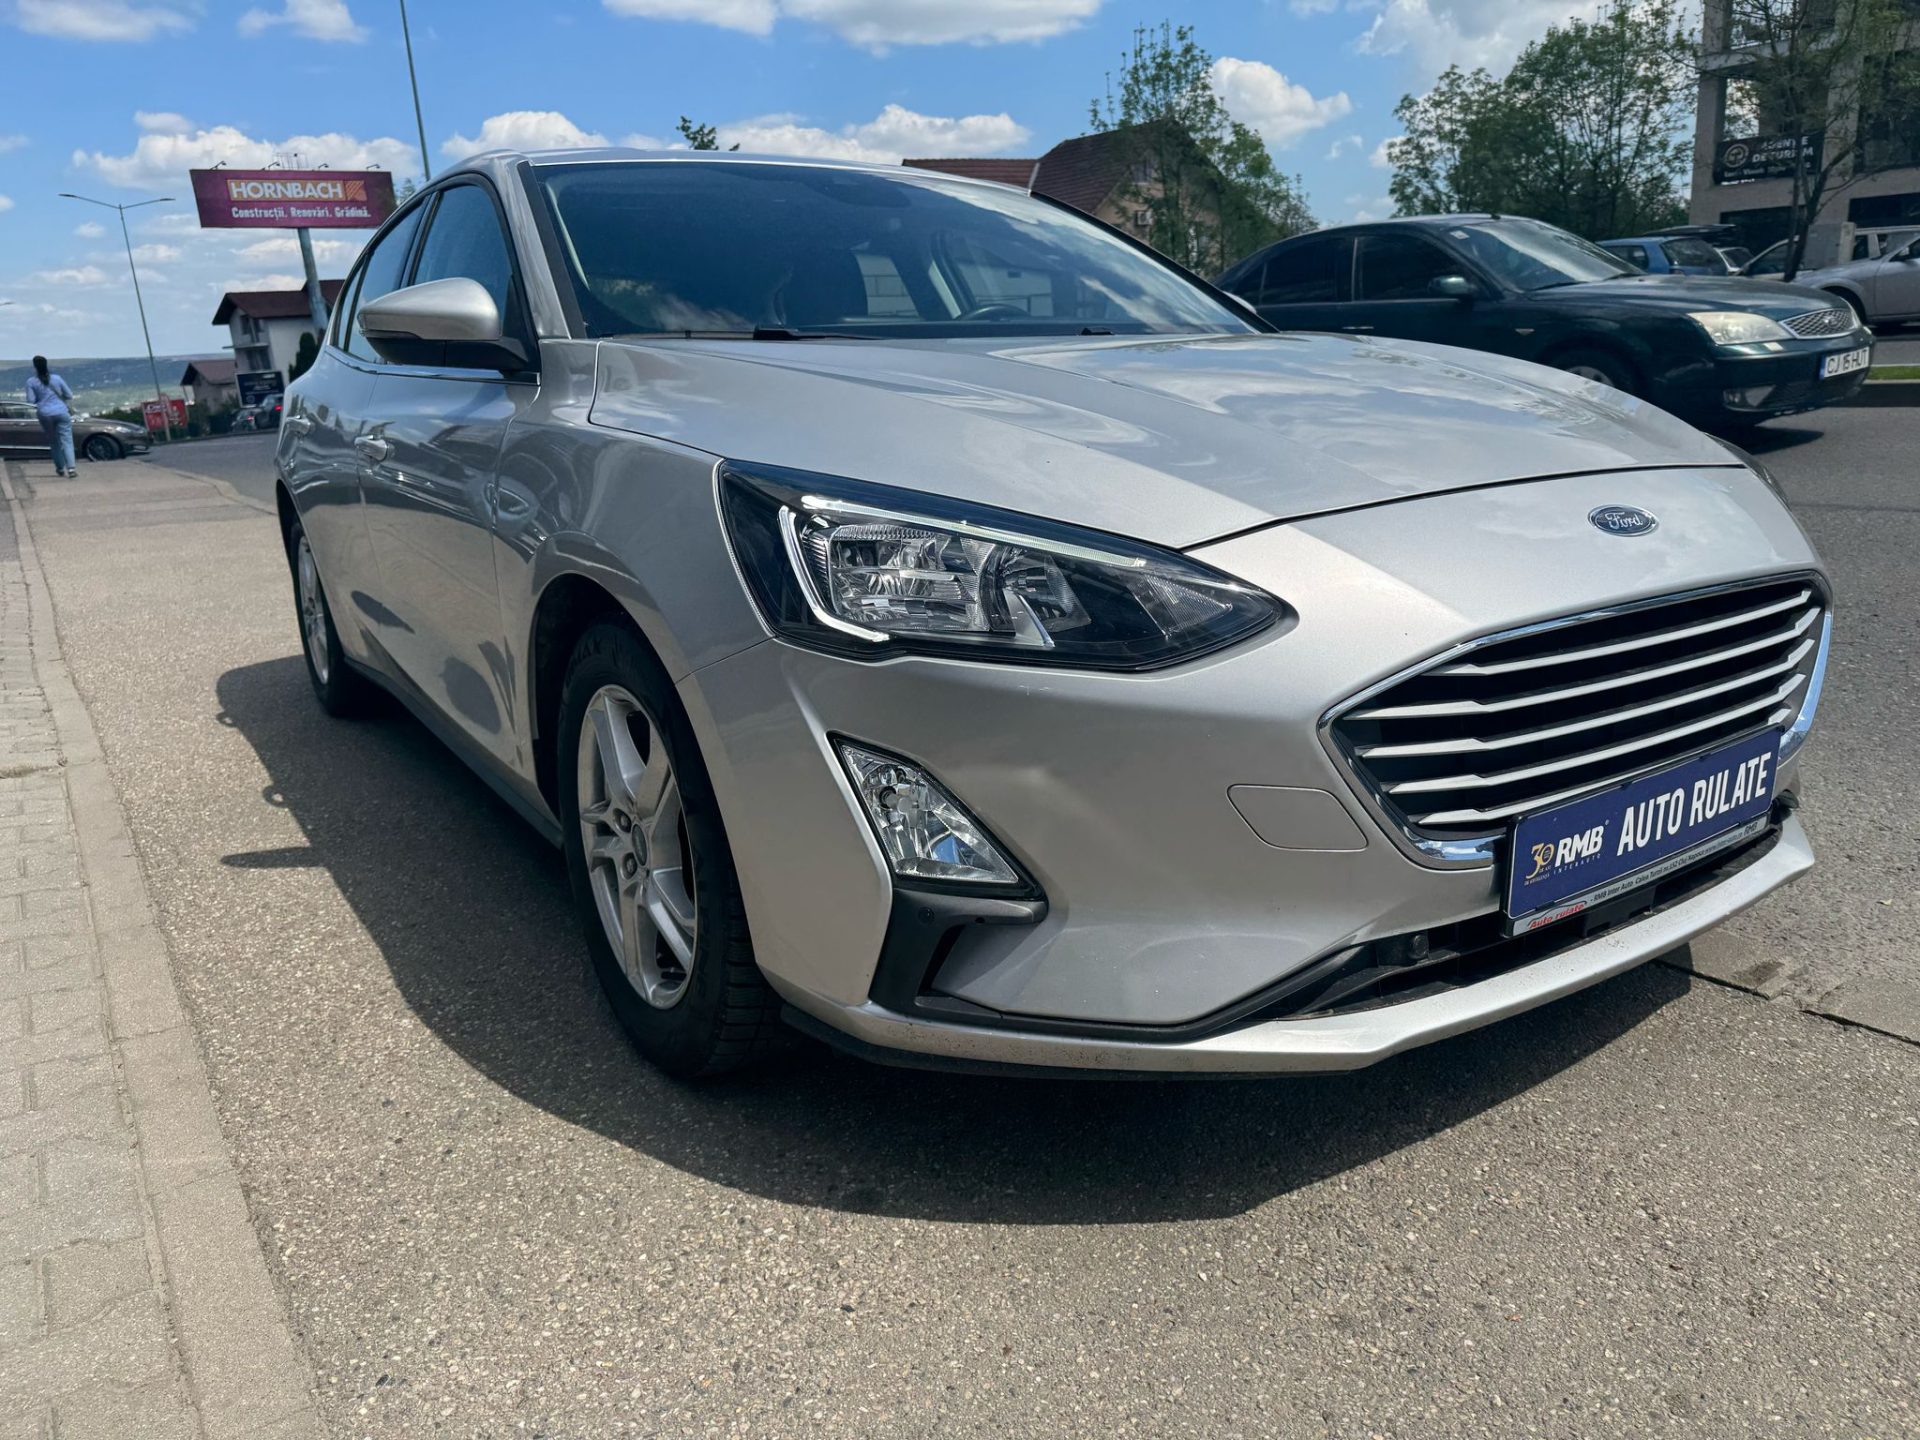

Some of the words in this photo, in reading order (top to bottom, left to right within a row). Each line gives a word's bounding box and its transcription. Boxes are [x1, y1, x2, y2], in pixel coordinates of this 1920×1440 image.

[231, 182, 343, 199] HORNBACH
[1604, 512, 1643, 530] Ford
[1617, 788, 1685, 856] AUTO
[1689, 752, 1772, 826] RULATE
[1555, 825, 1604, 868] RMB
[1530, 916, 1553, 929] Auto
[1555, 903, 1585, 919] rulate
